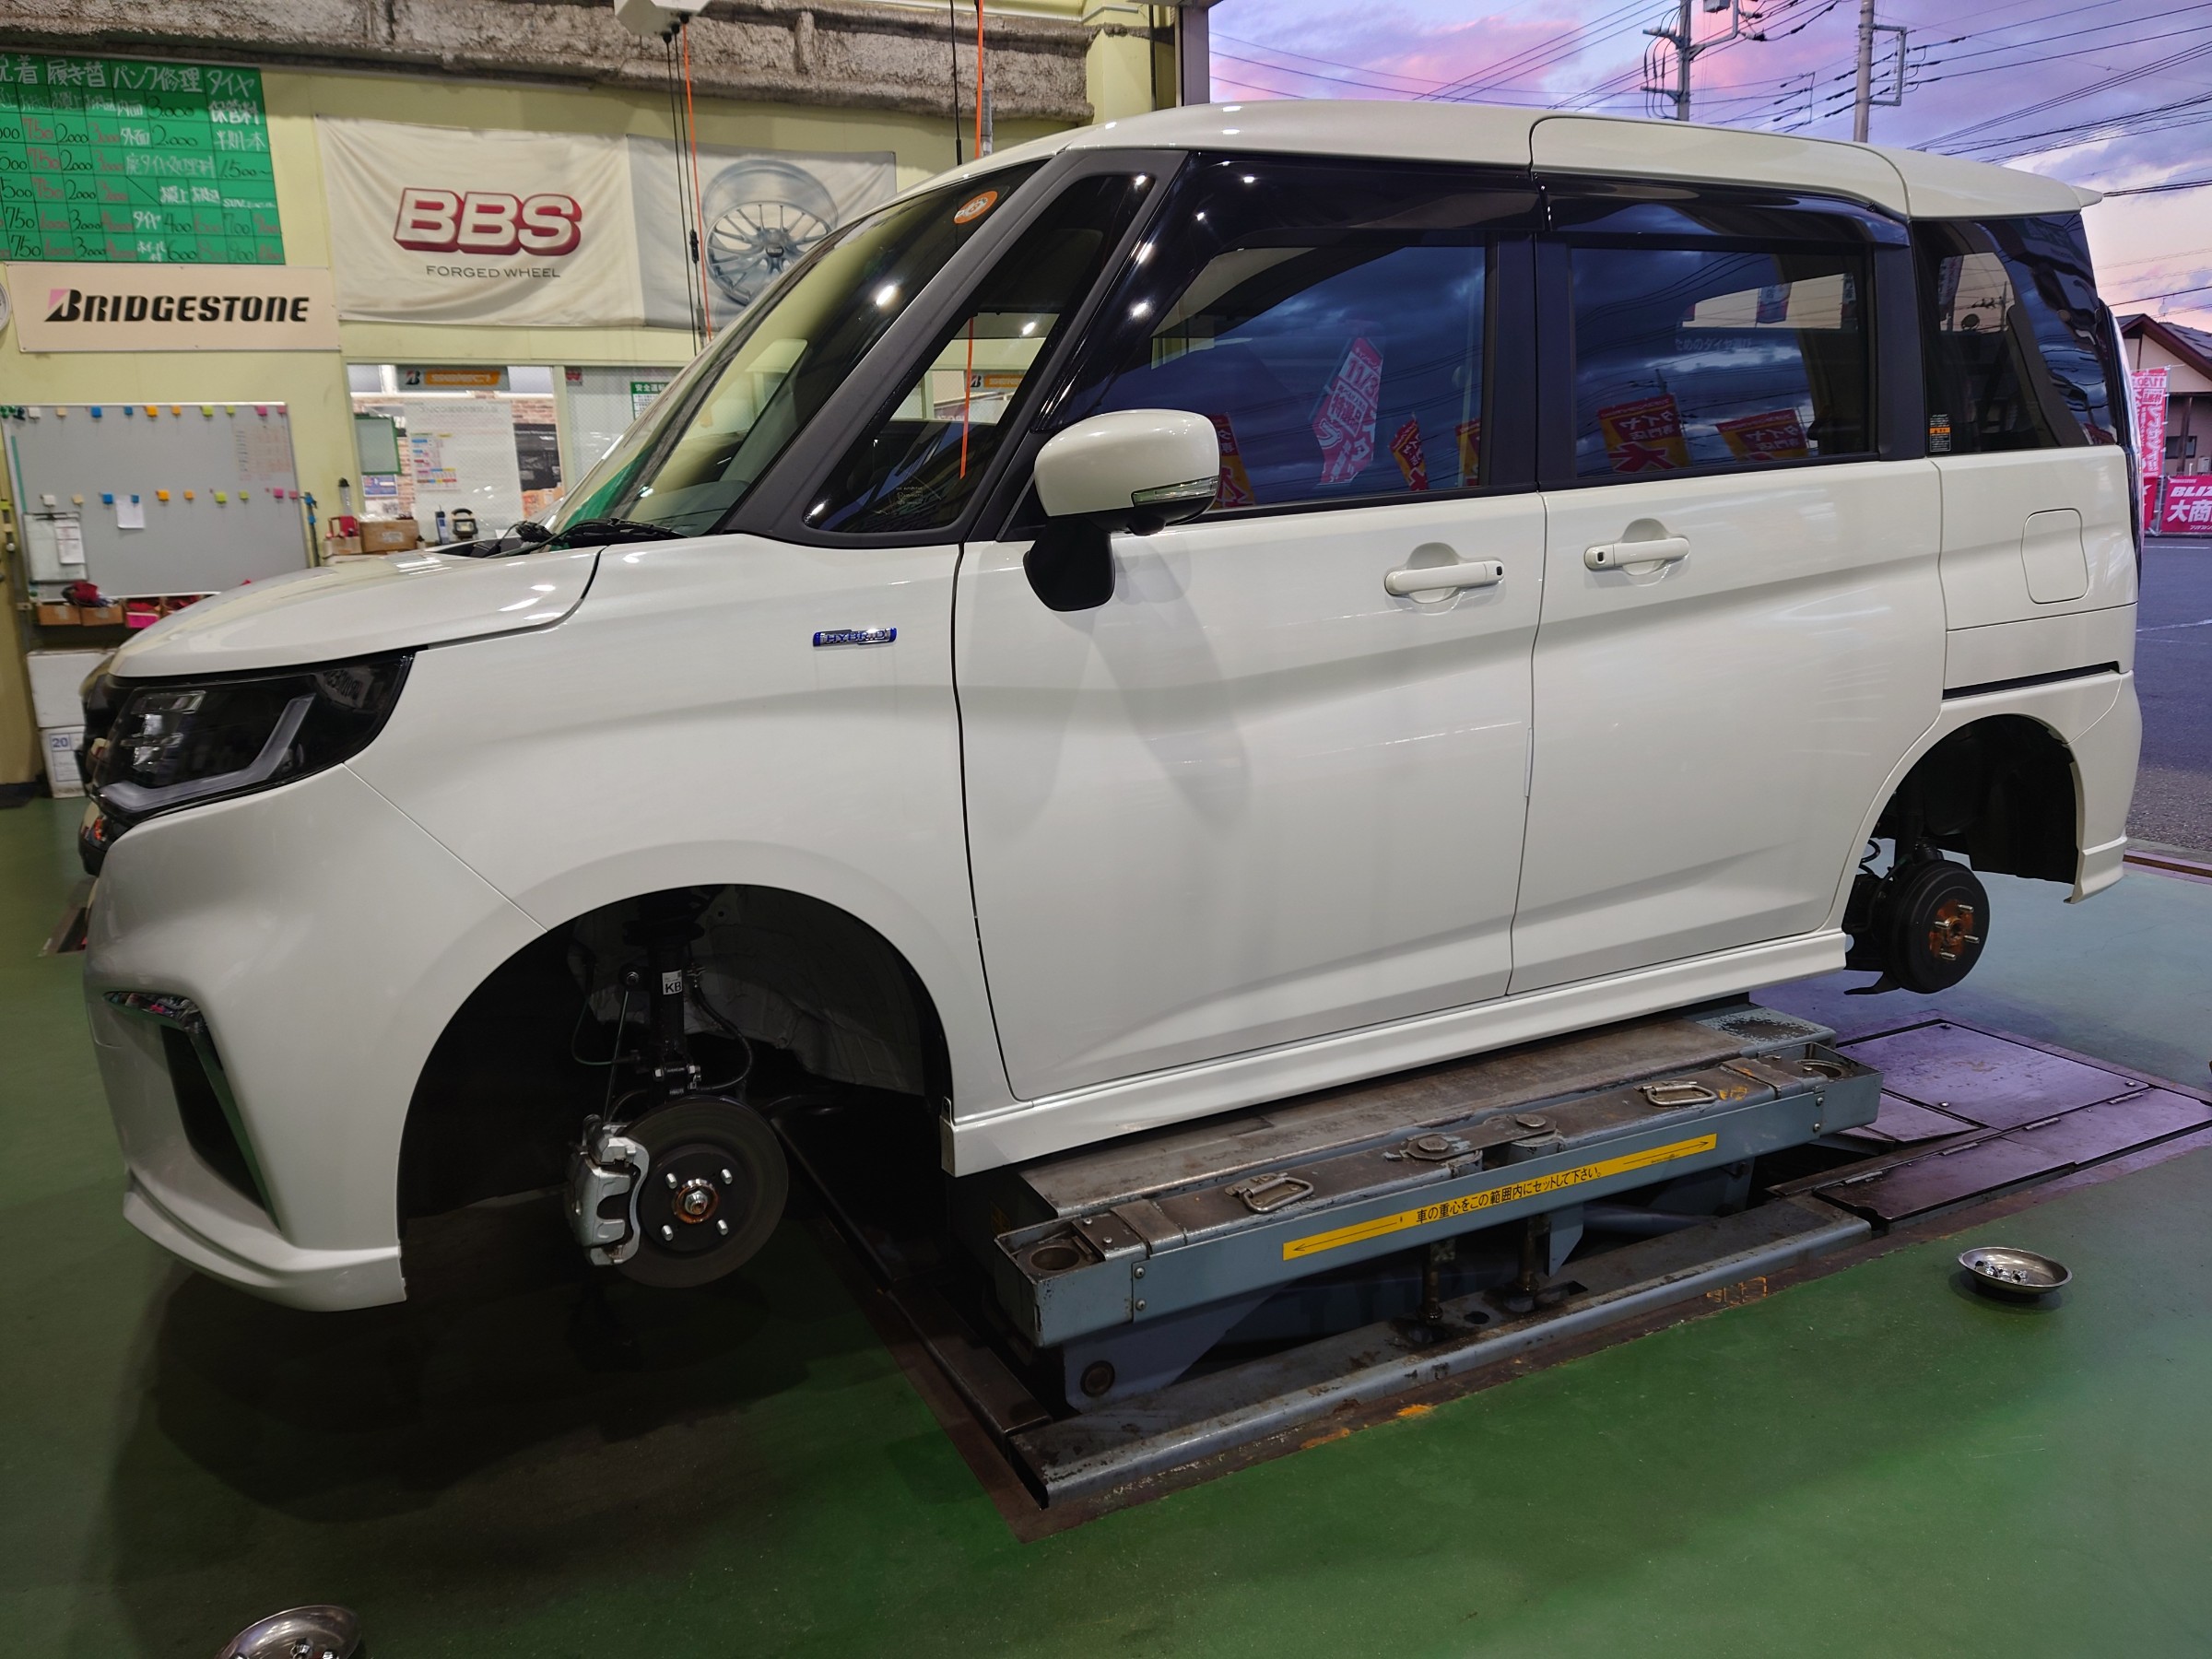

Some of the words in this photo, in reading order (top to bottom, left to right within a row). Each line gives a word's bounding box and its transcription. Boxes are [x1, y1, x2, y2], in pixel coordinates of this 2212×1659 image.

[47, 59, 106, 88] 履き替
[113, 65, 203, 92] パンク修理
[206, 70, 255, 98] タイヤ
[209, 99, 260, 125] 保管料
[0, 126, 20, 139] 00
[6, 206, 35, 229] 750
[393, 187, 582, 256] BBS
[11, 234, 41, 257] 750
[426, 265, 501, 277] FORGED
[504, 267, 560, 278] WHEEL
[44, 288, 310, 323] BRIDGESTONE
[2167, 500, 2212, 523] 大商
[827, 630, 885, 643] HYBRID
[53, 738, 68, 747] 20
[665, 982, 681, 993] KB
[1417, 1167, 1602, 1223] 車の重心をこの範囲内にセットして下さい。
